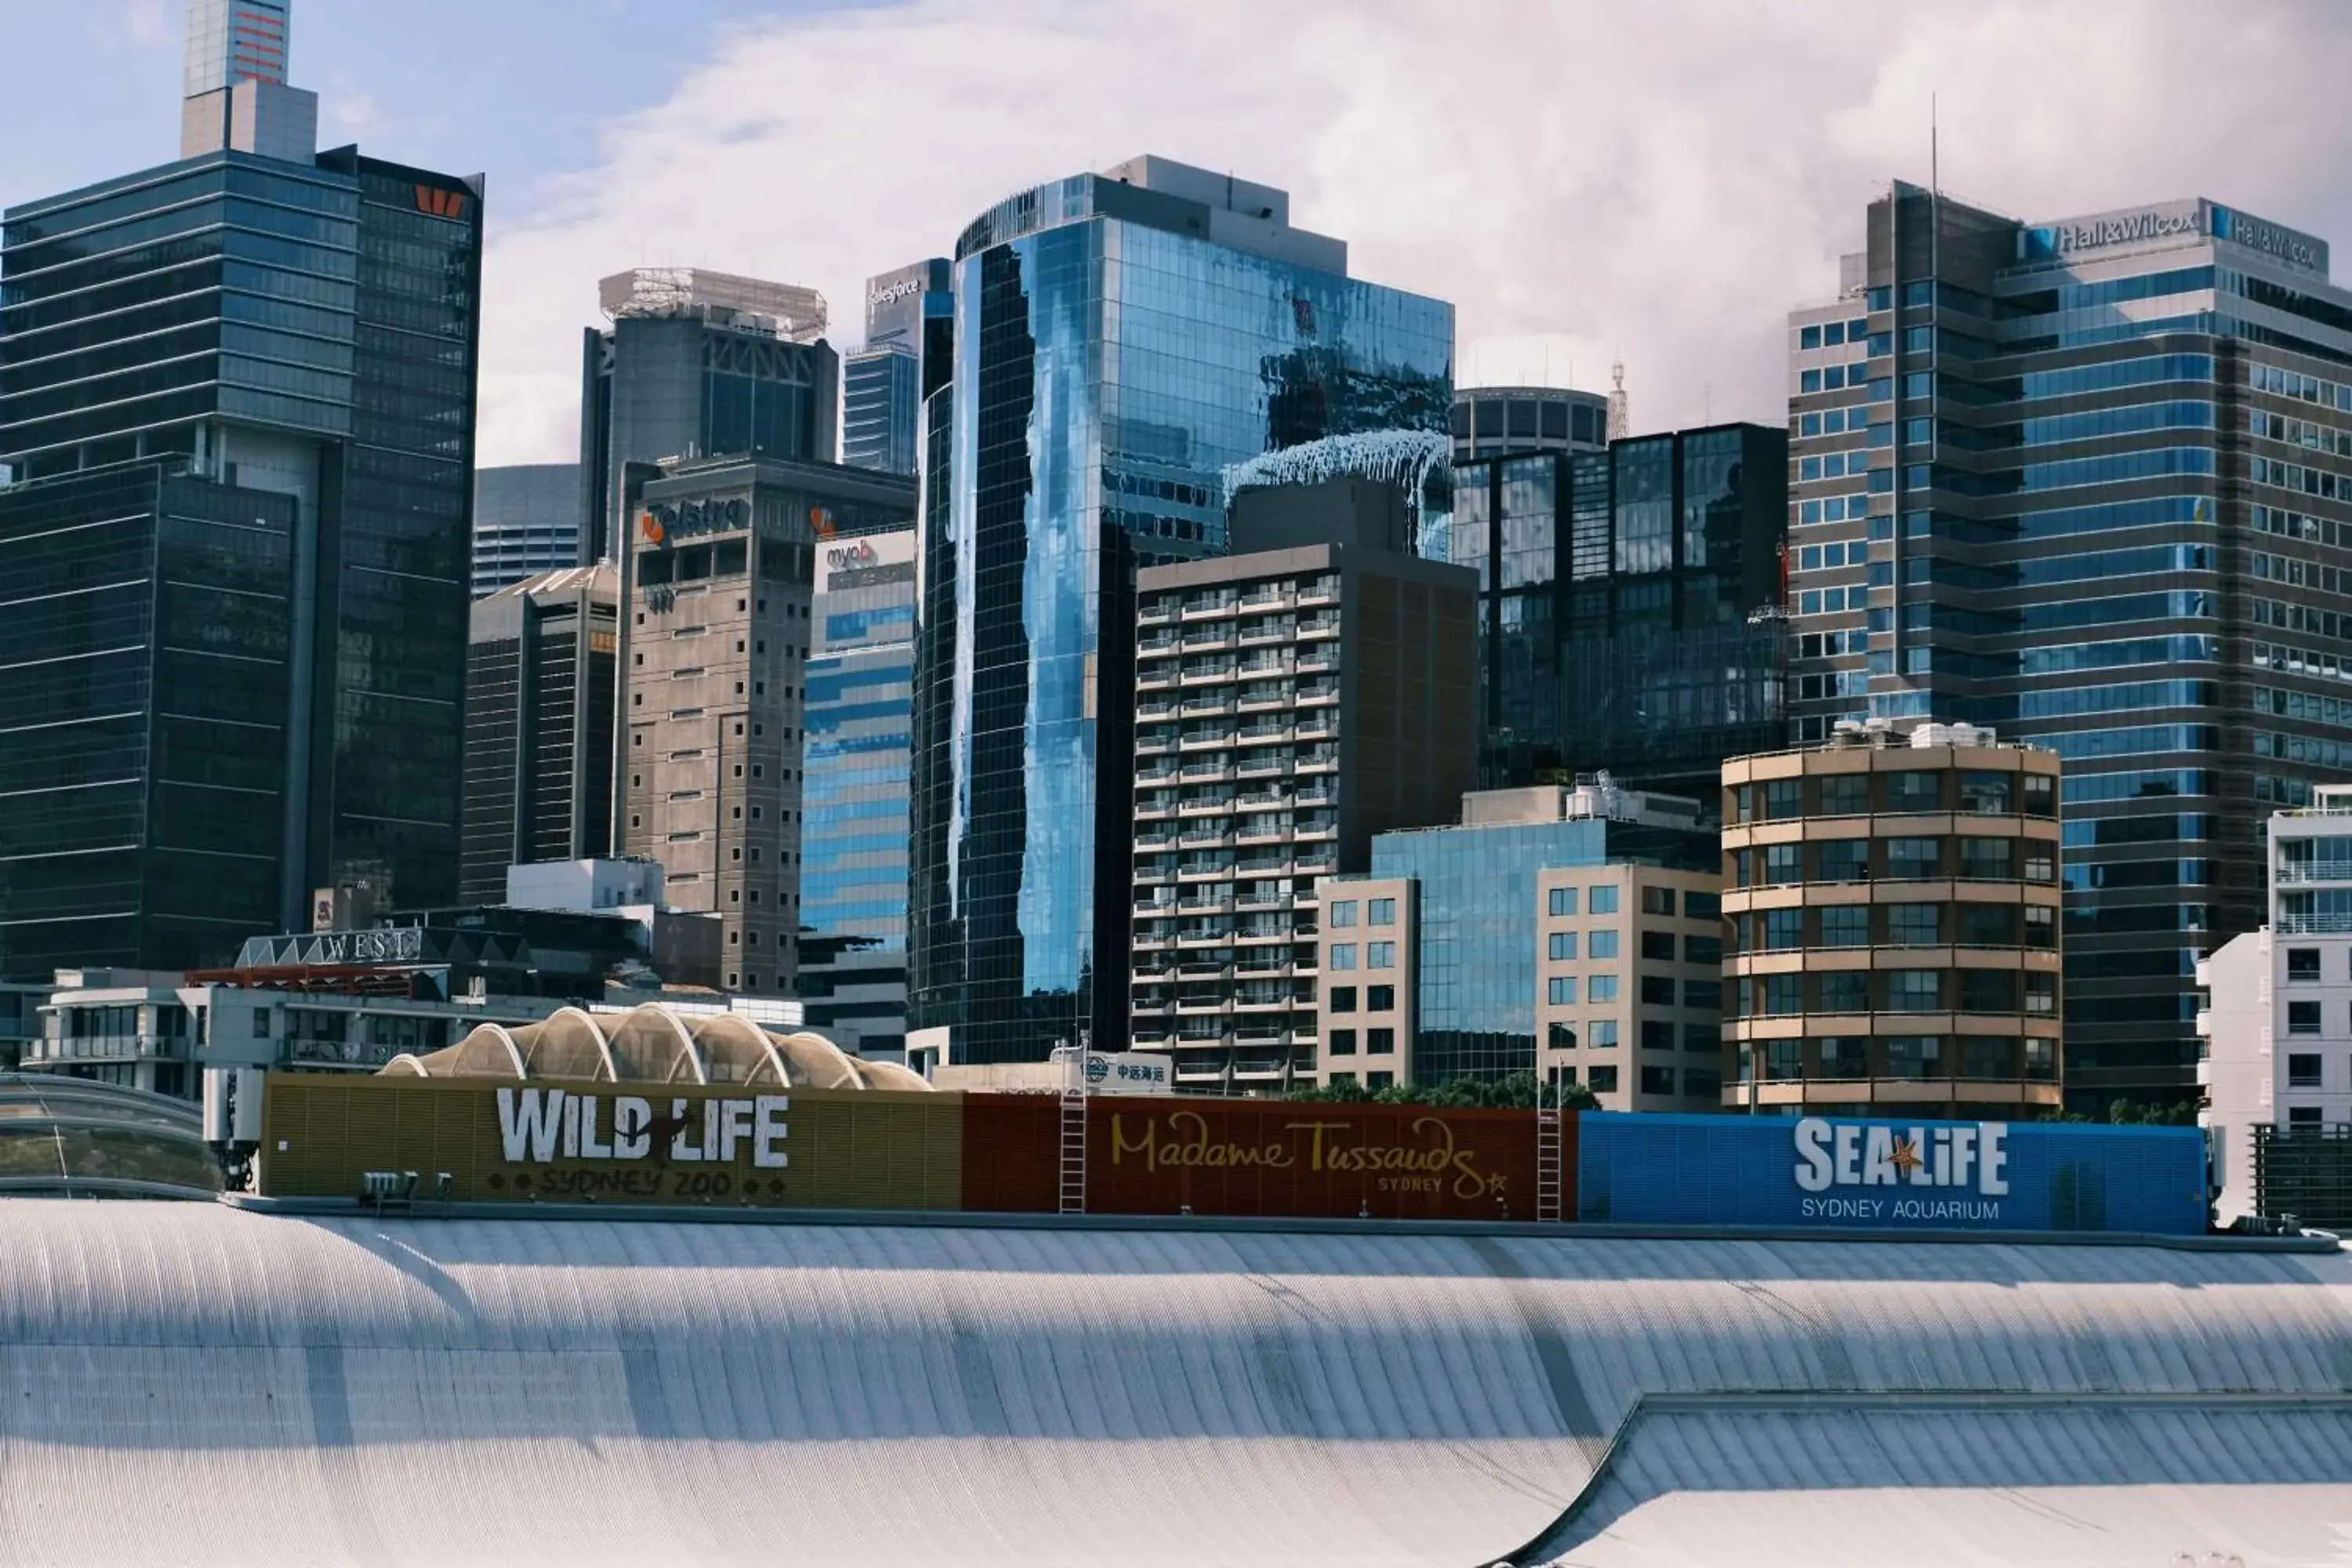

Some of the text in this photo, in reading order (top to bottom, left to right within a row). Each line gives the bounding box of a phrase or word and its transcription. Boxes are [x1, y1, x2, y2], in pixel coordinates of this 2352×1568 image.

[2060, 212, 2198, 253] Hall&Wilcox
[641, 497, 746, 543] Telstra
[328, 930, 407, 961] WEST
[496, 1087, 789, 1168] WILD LIFE
[1111, 1110, 1486, 1200] Madame Tussauds
[1794, 1117, 1897, 1192] SEA
[539, 1167, 732, 1196] SYDNEY ZOO
[1377, 1177, 1443, 1192] SYDNEY
[1802, 1198, 2000, 1220] SYDNEY AQUARIUM
